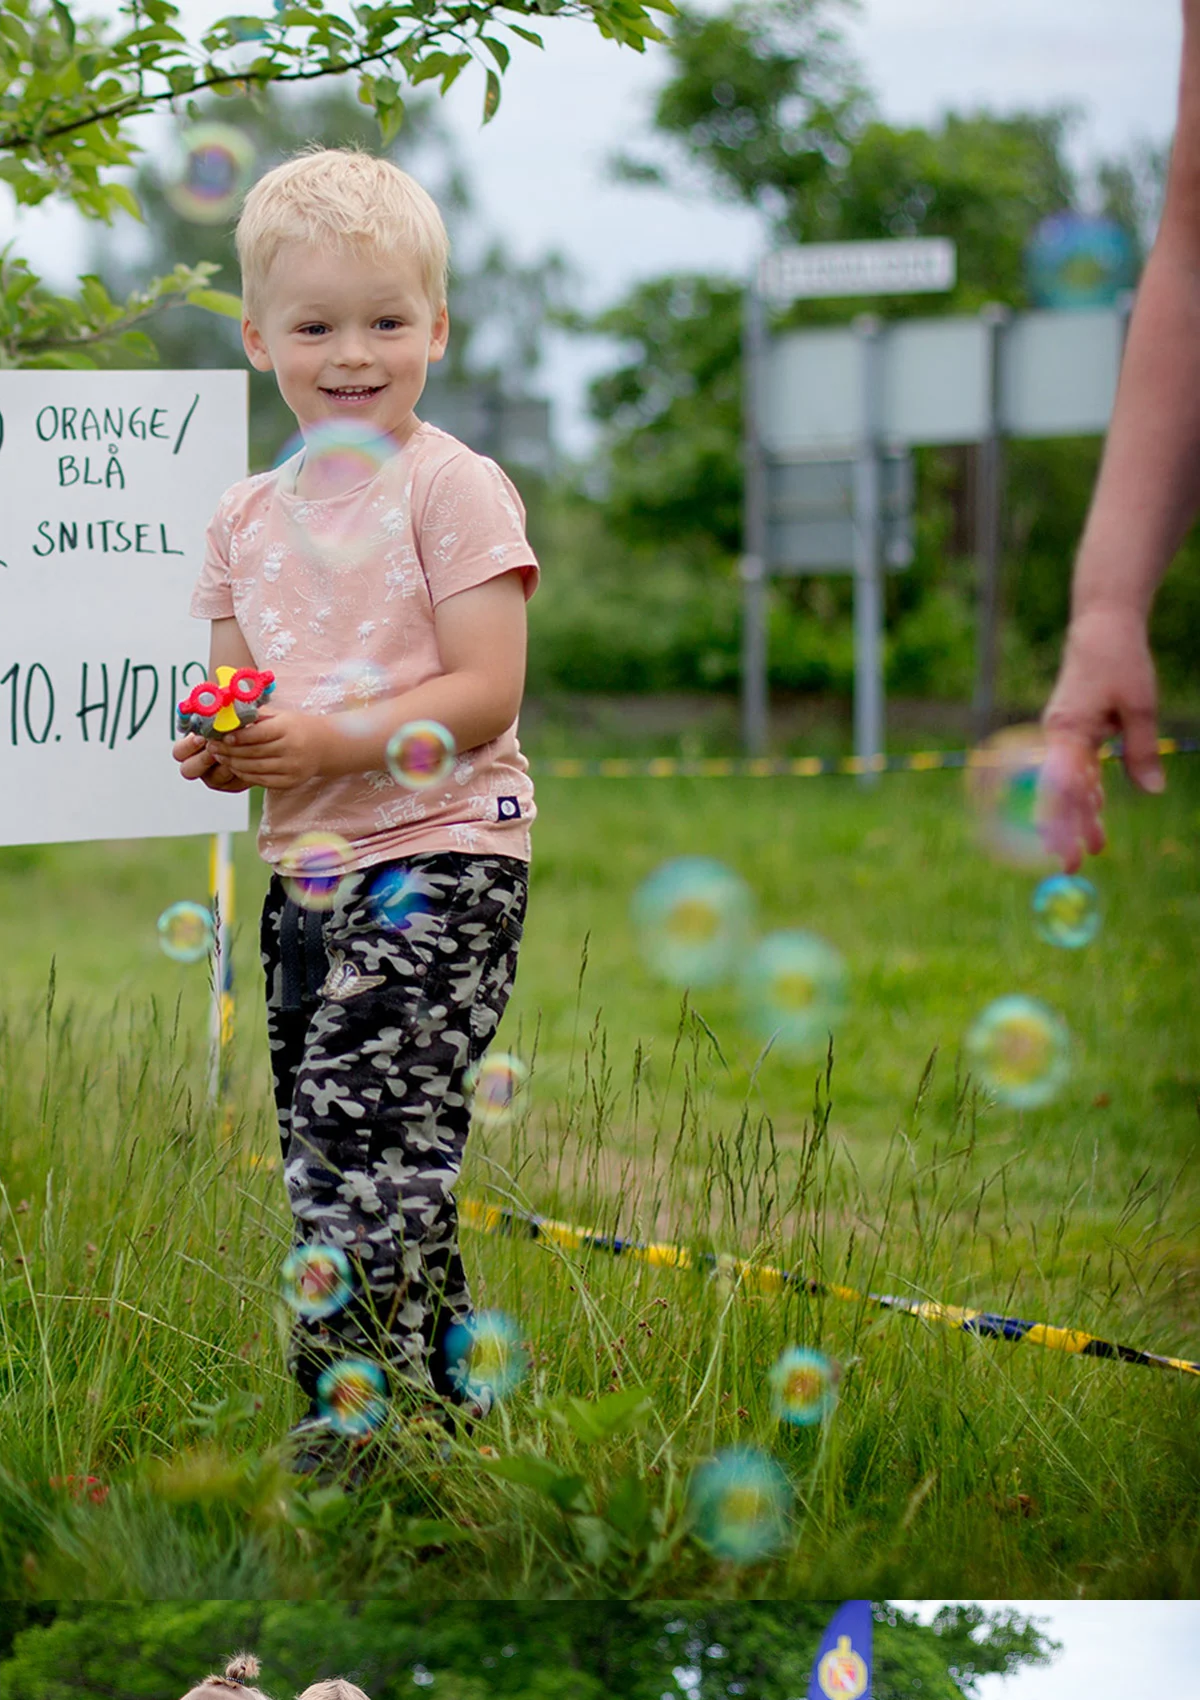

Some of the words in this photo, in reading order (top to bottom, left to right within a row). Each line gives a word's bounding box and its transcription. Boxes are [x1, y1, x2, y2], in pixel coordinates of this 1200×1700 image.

[35, 393, 200, 459] ORANGE/
[58, 443, 127, 491] BLÅ
[32, 519, 185, 557] SNITSEL
